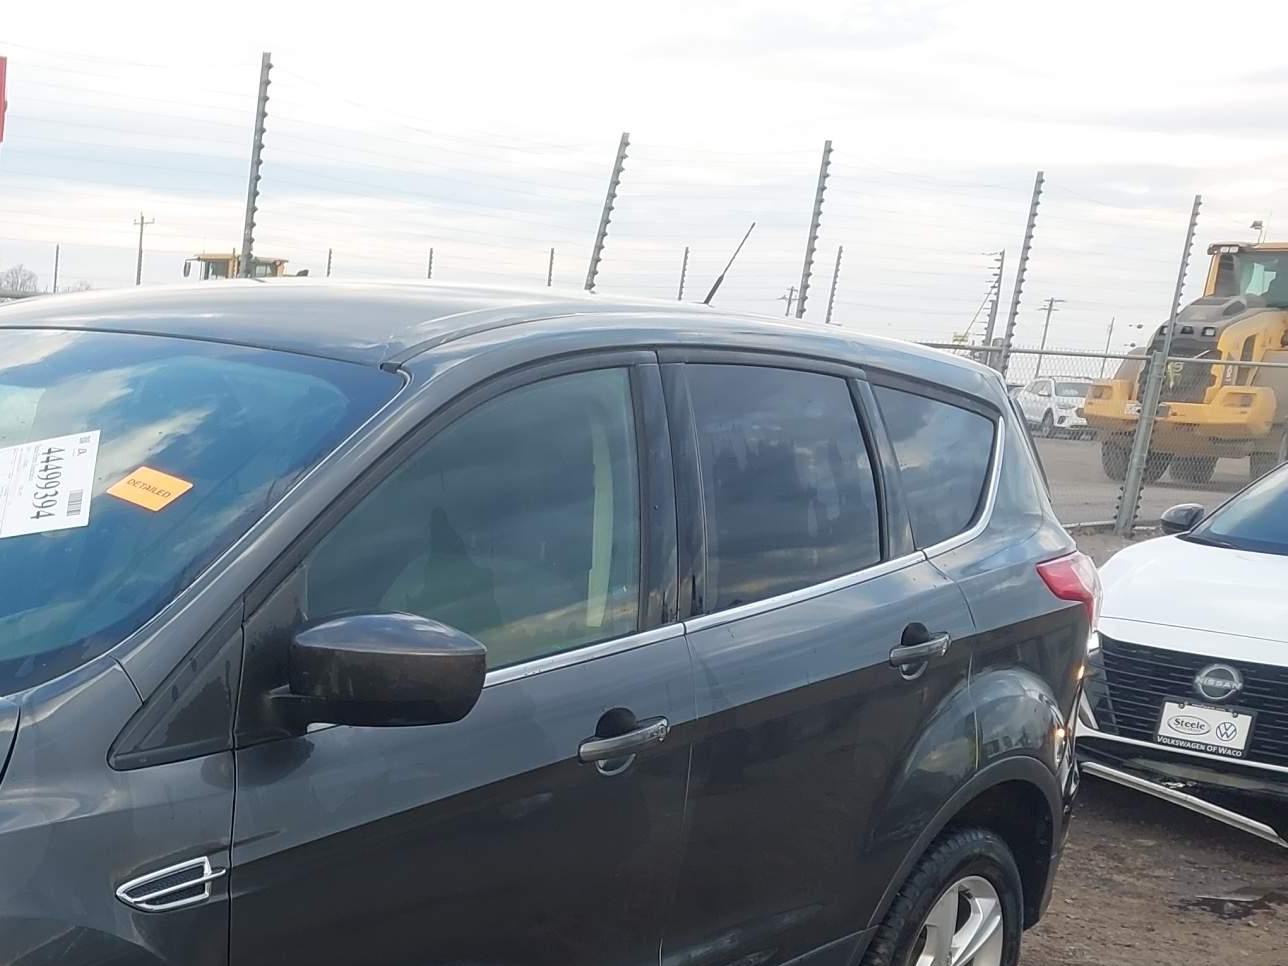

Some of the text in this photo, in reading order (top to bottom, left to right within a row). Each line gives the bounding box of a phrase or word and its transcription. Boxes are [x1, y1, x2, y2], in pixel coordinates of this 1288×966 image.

[30, 447, 66, 519] 44499394
[127, 478, 172, 498] DETAILED
[1194, 675, 1243, 690] NISSAN
[1173, 717, 1206, 731] Steele
